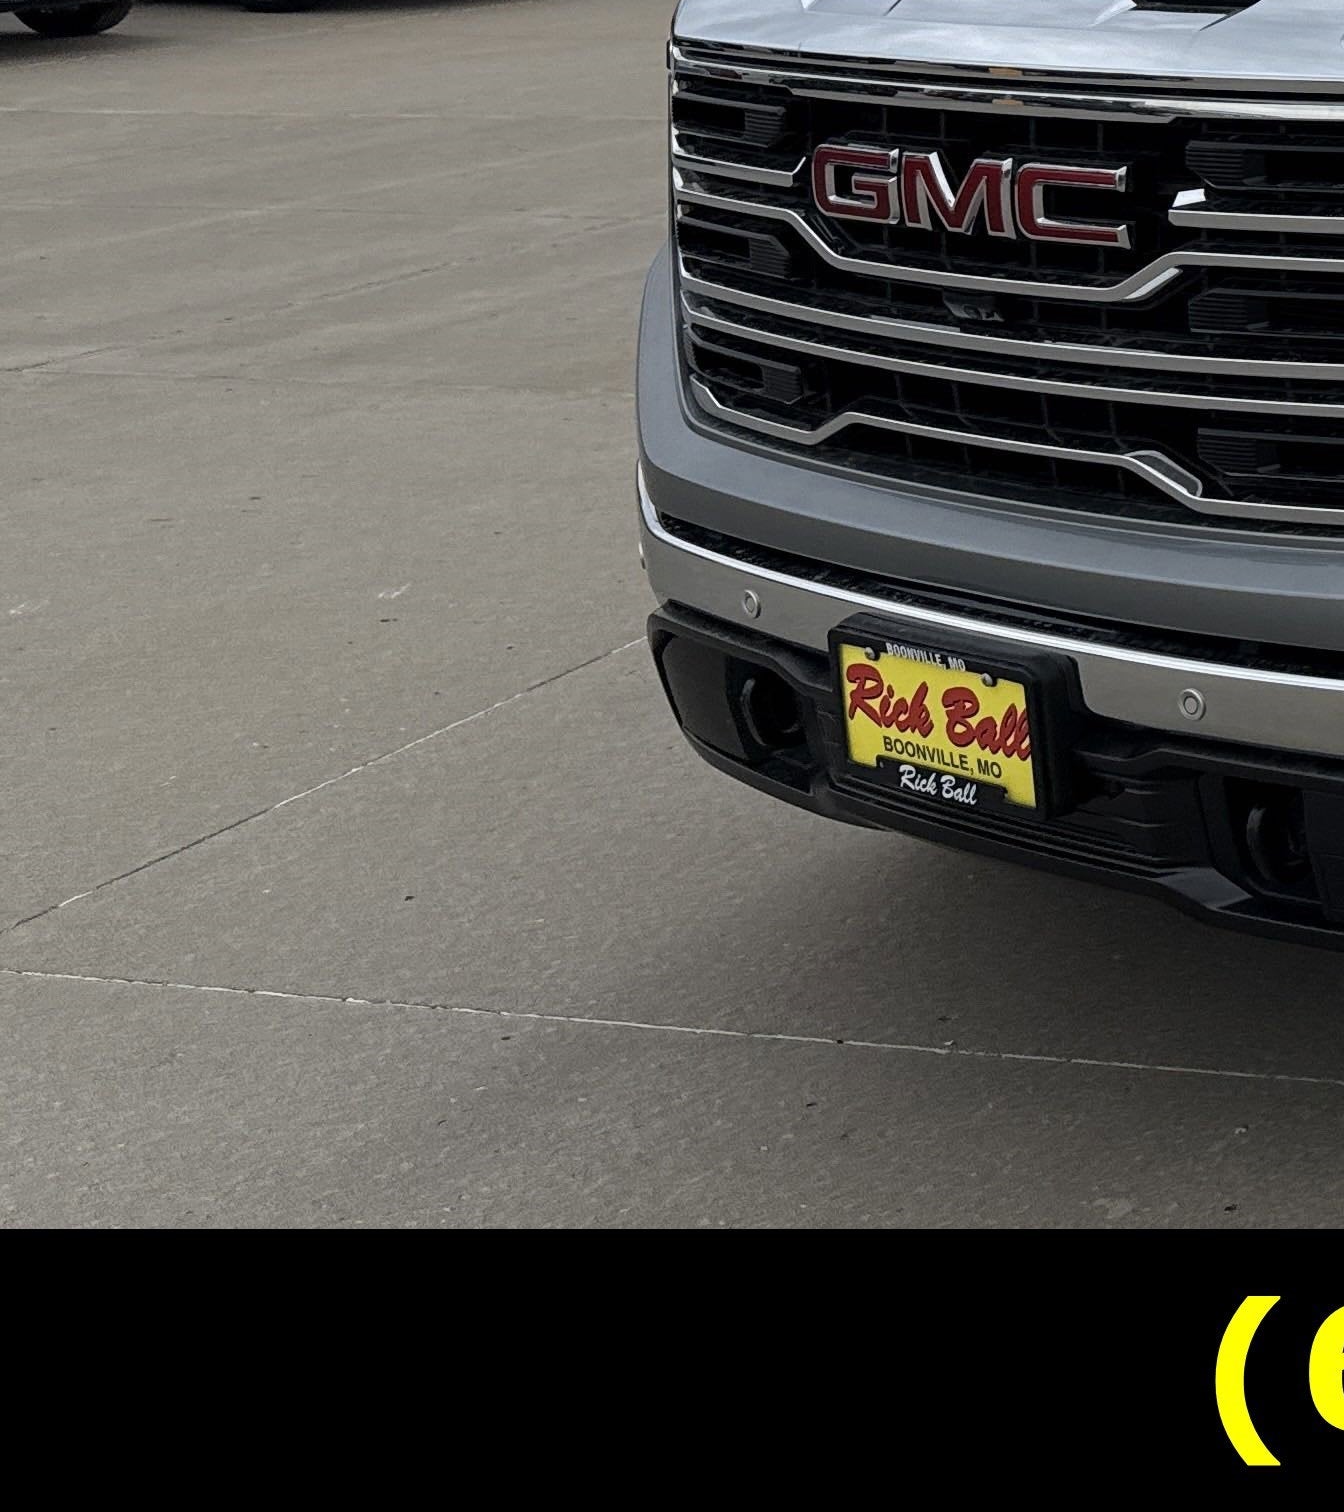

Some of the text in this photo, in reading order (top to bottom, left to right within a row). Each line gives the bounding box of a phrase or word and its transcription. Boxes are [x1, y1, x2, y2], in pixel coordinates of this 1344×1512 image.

[811, 143, 1132, 250] GMC
[885, 642, 966, 672] BOONVILLE, MO
[846, 663, 1031, 761] Rick Ball
[882, 736, 1002, 779] BOONVILLE, MO
[899, 764, 978, 806] Rick Ball
